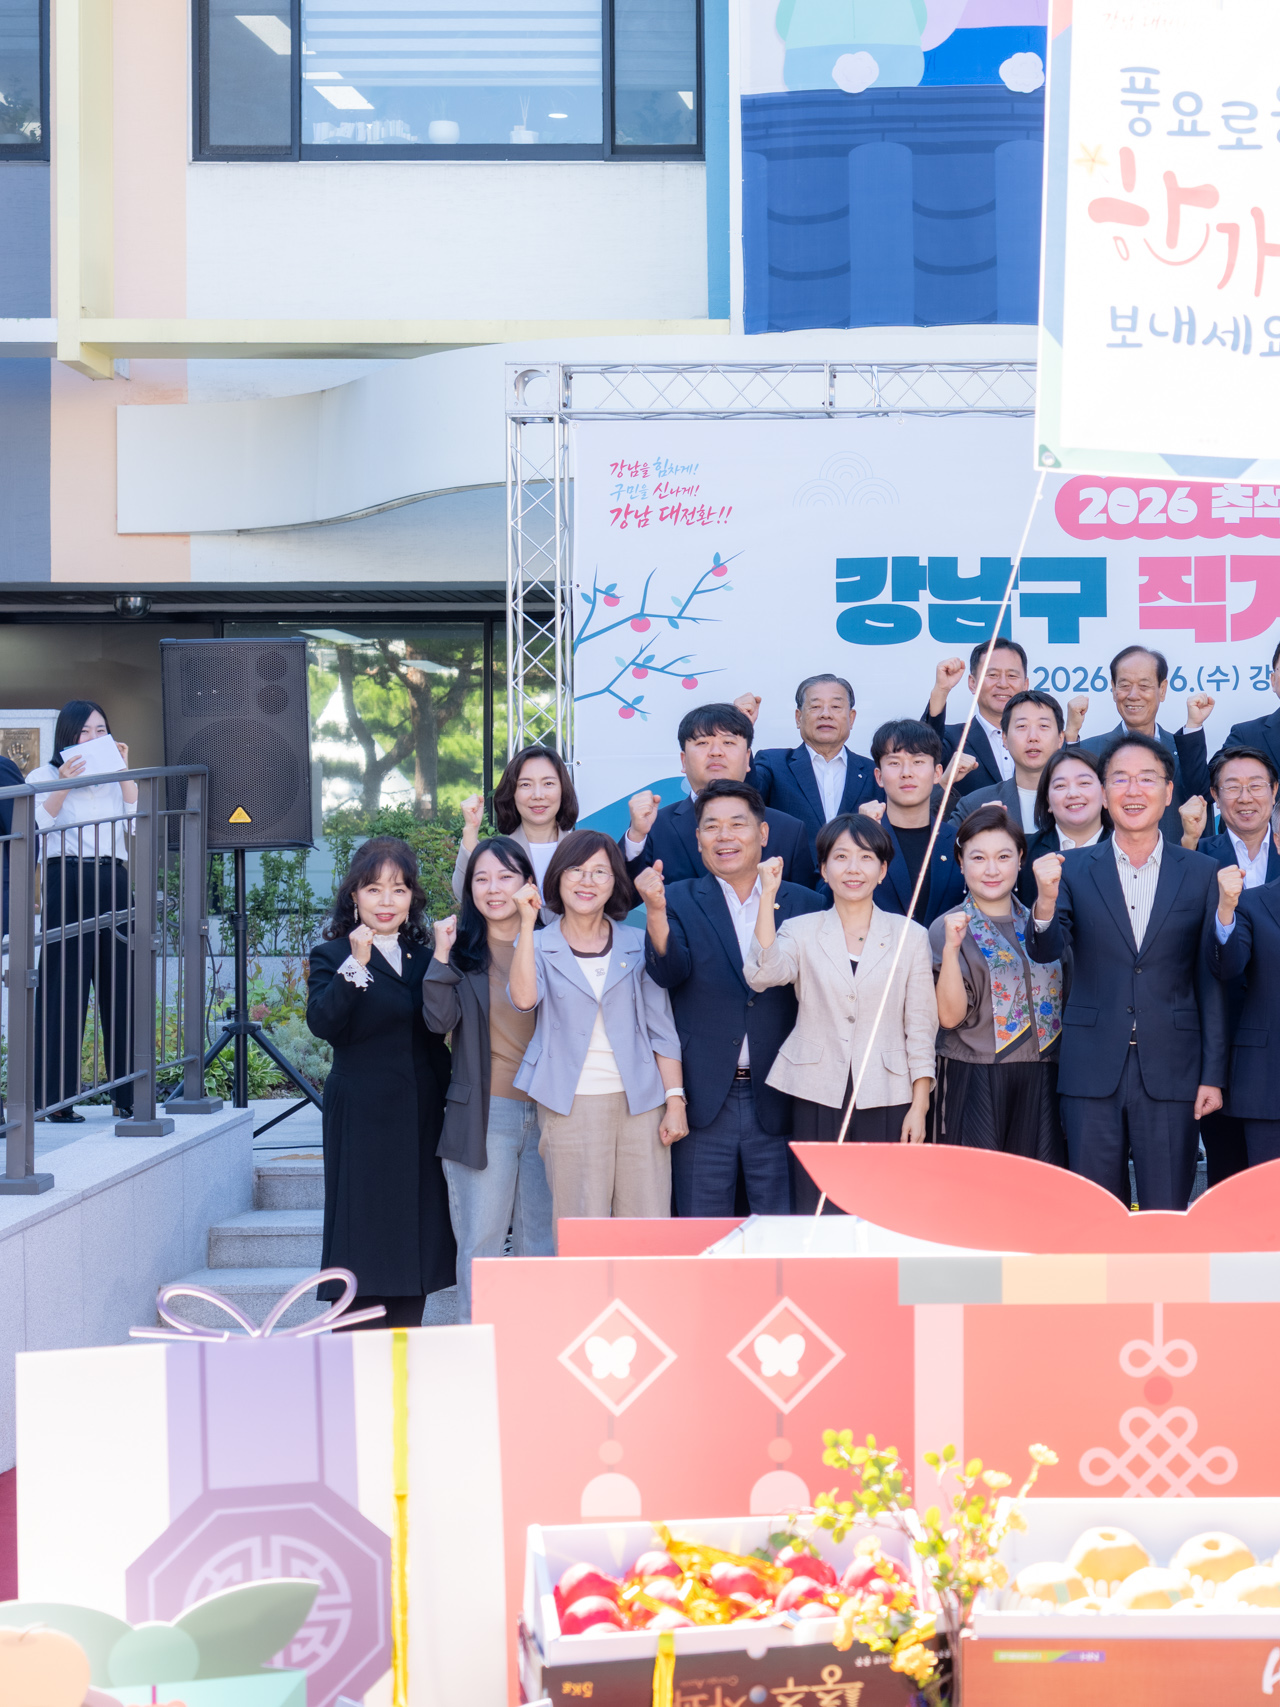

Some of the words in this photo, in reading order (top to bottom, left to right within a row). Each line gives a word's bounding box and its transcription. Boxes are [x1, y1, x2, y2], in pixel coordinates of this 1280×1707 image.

[610, 459, 650, 478] 강남을
[653, 456, 699, 477] 힘차게!
[610, 483, 649, 502] 구민을
[653, 481, 700, 500] 신나게!
[610, 503, 653, 529] 강남
[658, 502, 733, 526] 대전환!!
[1078, 486, 1198, 525] 2026
[835, 556, 1107, 645] 강남구
